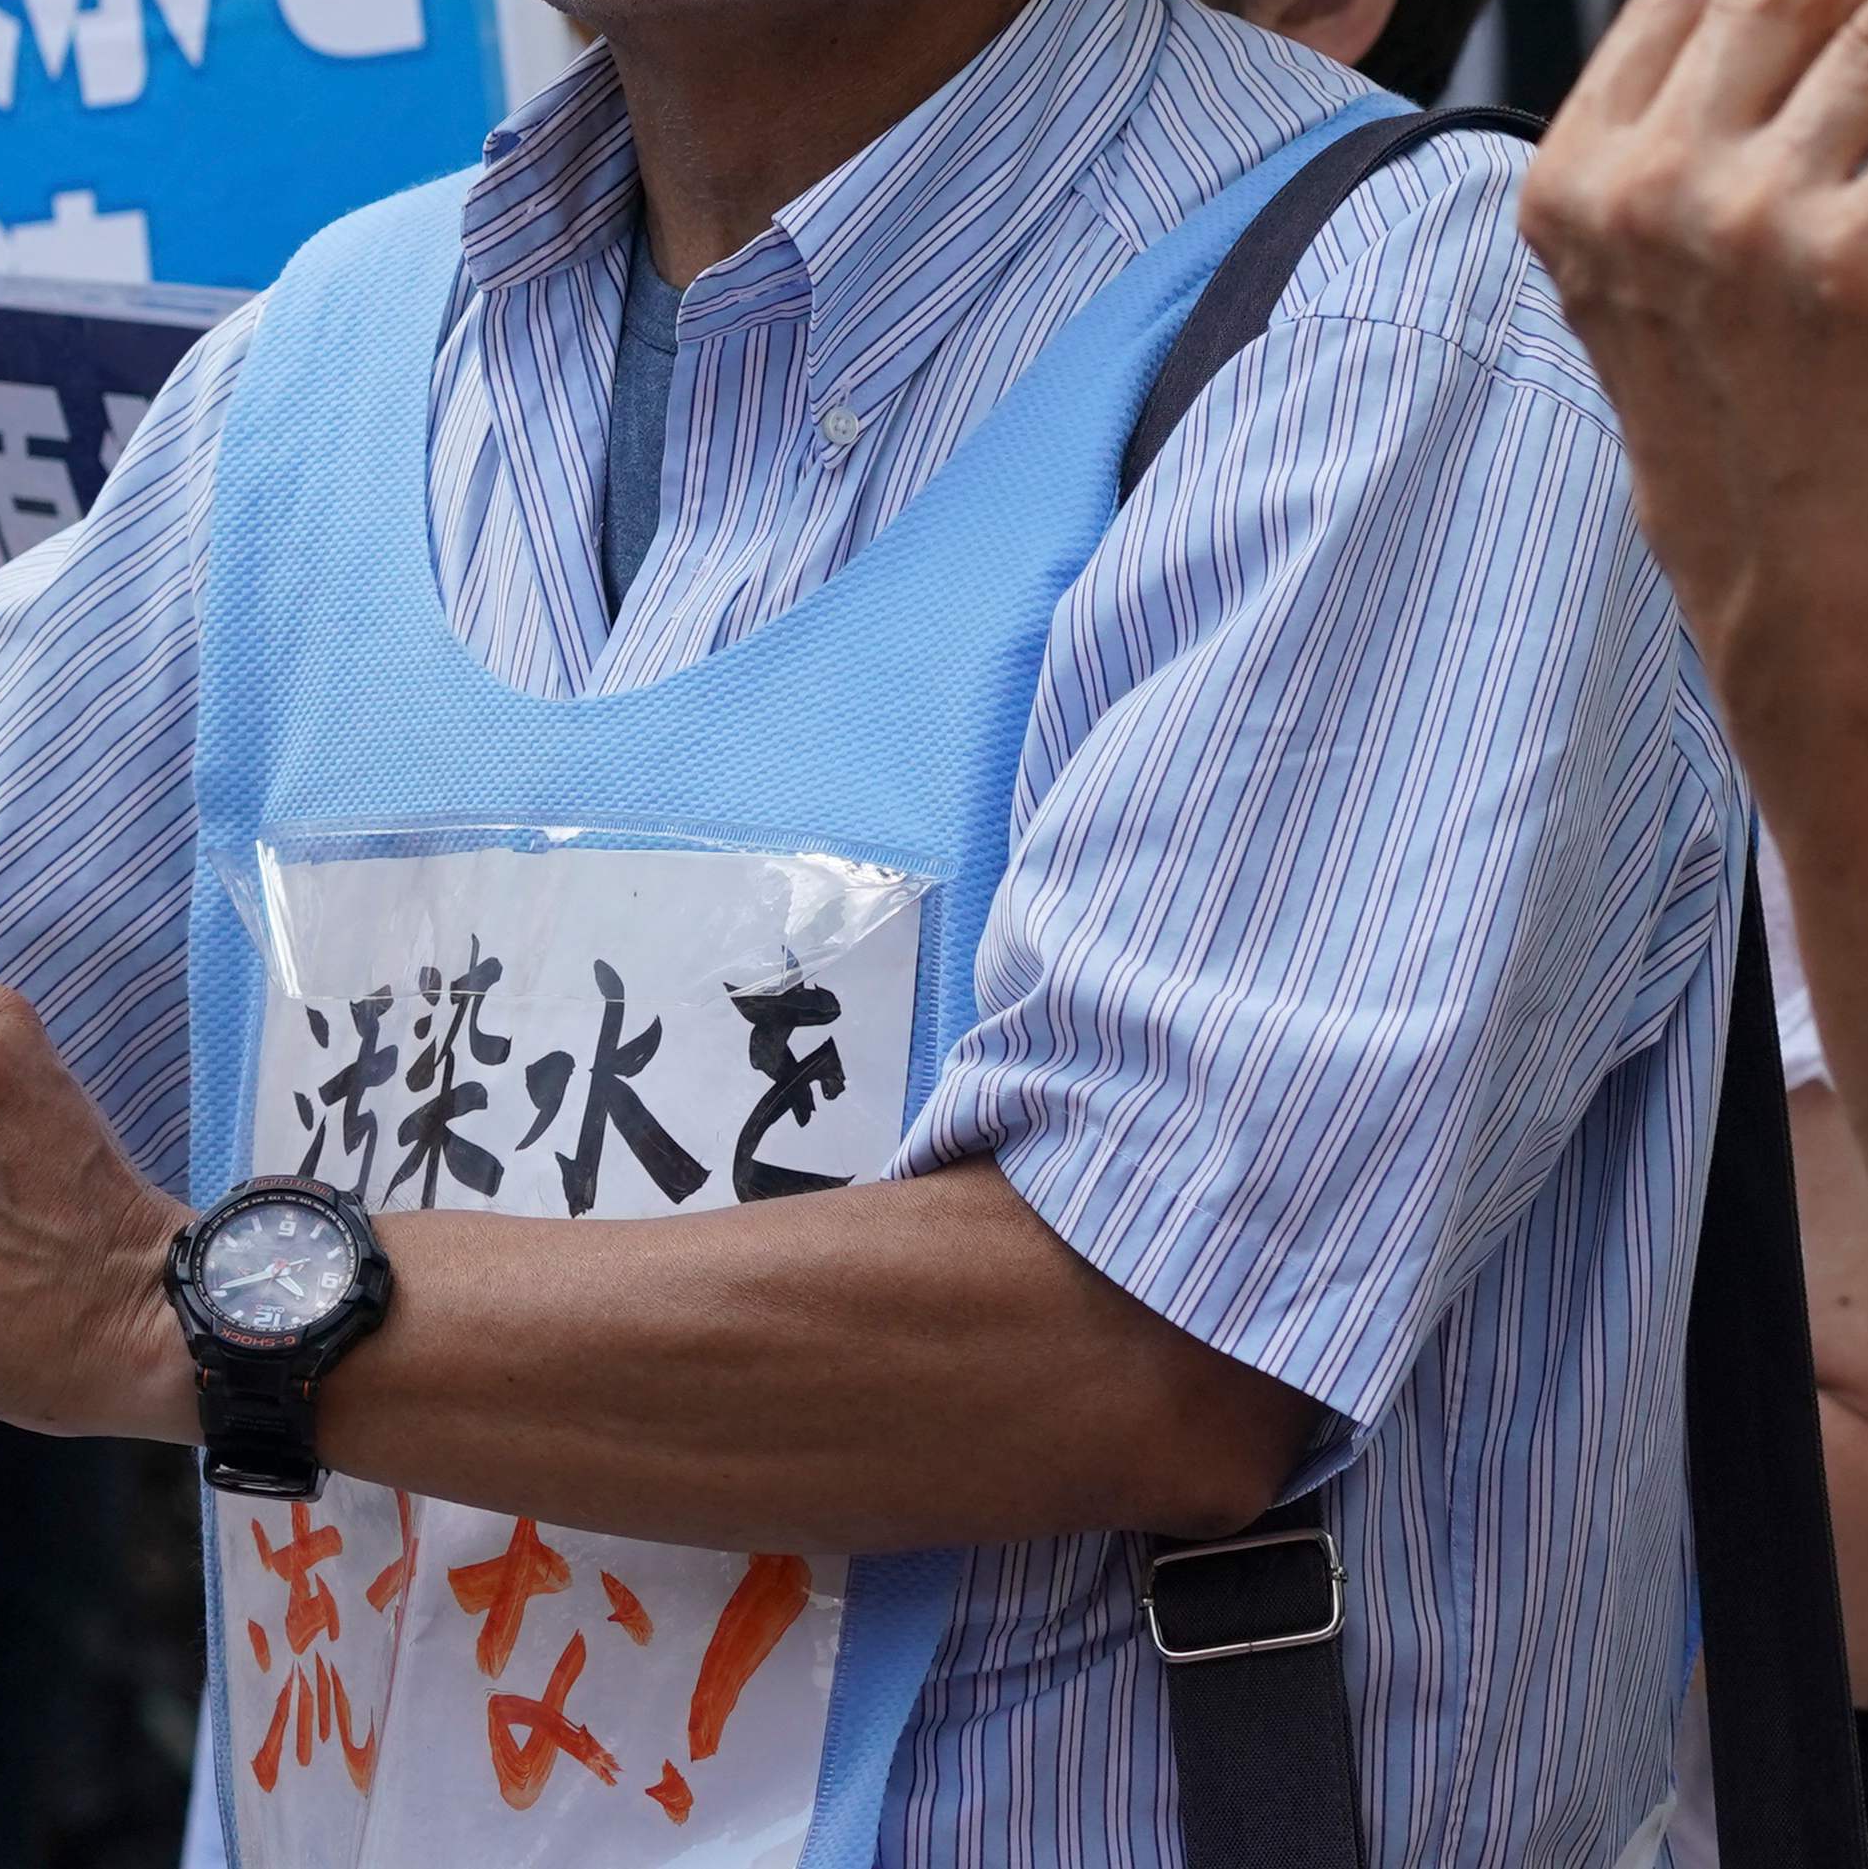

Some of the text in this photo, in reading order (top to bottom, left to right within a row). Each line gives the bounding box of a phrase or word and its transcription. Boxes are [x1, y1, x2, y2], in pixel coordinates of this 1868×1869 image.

[293, 934, 857, 1218] 汚染水を
[221, 1324, 297, 1348] G-SHOCK
